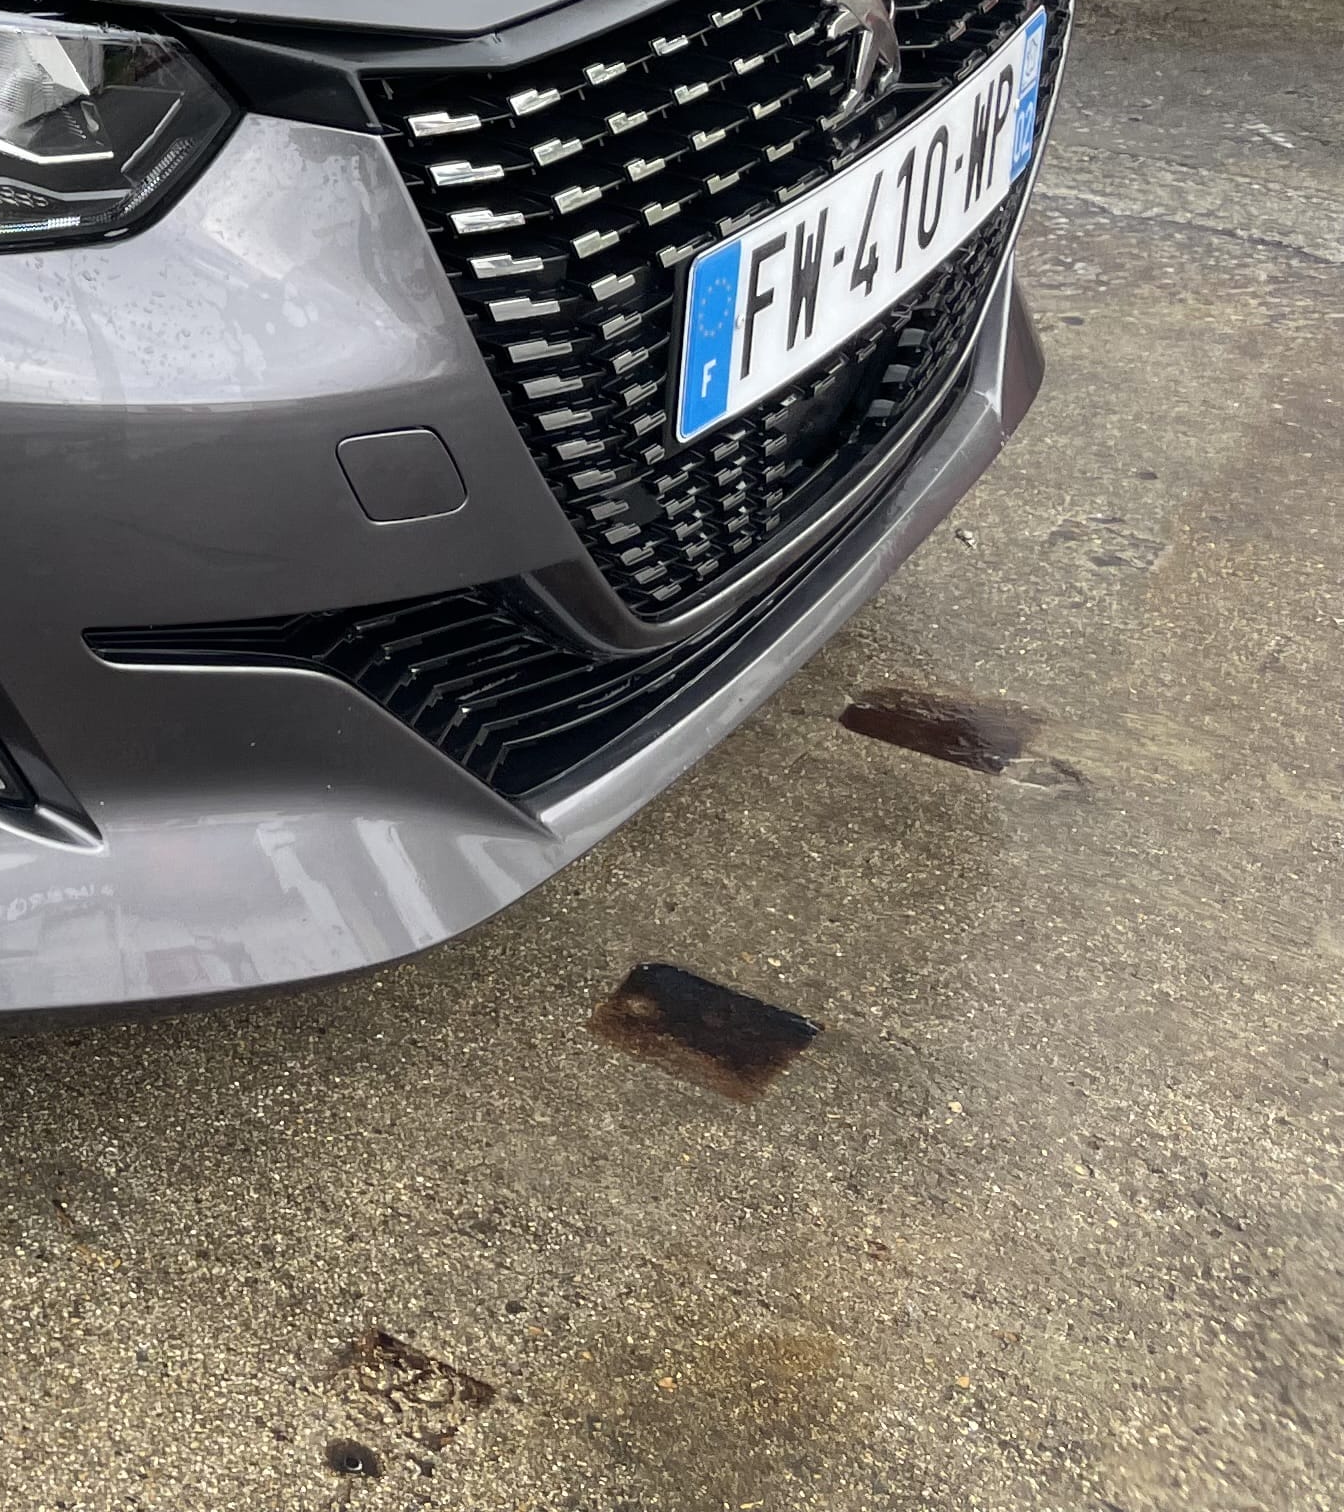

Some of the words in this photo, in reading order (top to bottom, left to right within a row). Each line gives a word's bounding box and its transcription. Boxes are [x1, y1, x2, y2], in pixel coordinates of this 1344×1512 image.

[1014, 101, 1034, 163] 02
[740, 64, 1013, 381] FW-410-WP
[701, 359, 717, 398] F
